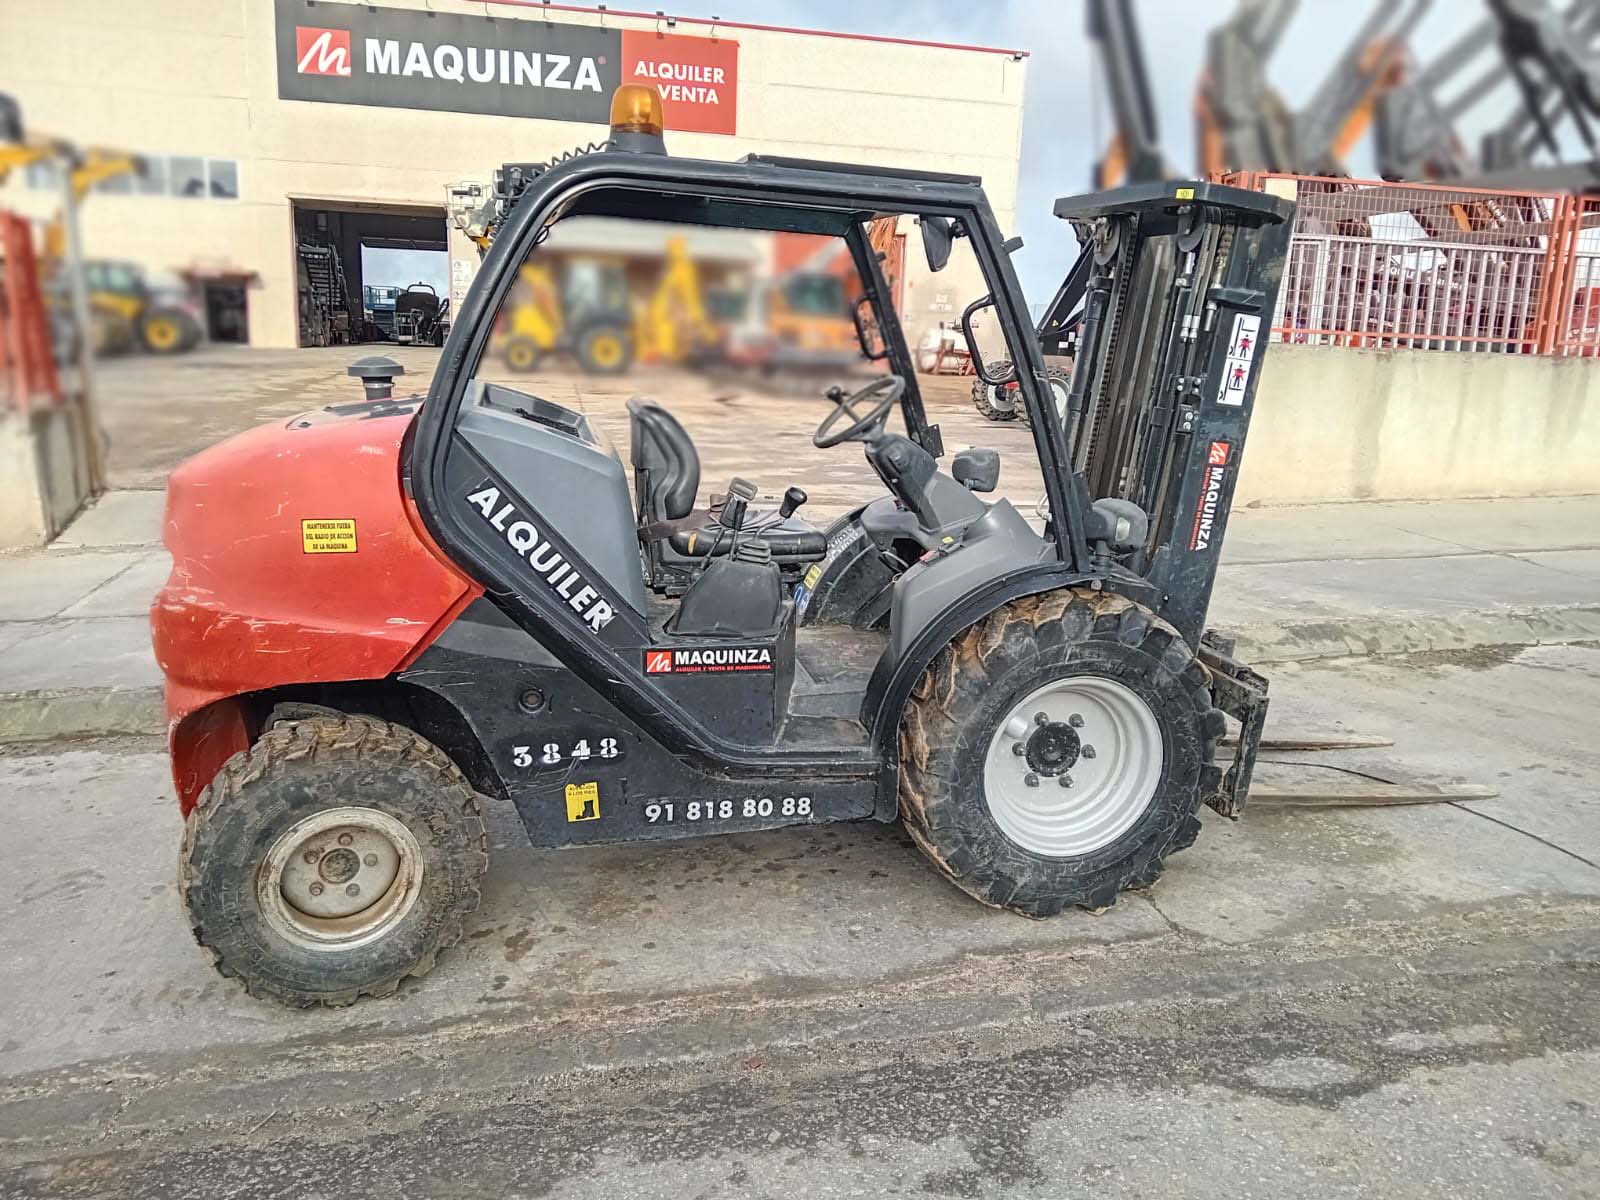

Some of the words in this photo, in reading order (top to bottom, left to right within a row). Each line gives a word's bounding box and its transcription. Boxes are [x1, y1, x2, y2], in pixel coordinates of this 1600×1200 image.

[365, 38, 603, 92] MAQUINZA
[634, 60, 725, 83] ALQUILER
[657, 83, 719, 104] VENTA
[1195, 467, 1224, 551] MAQUINZA
[466, 486, 617, 635] ALQUILER
[675, 649, 771, 665] MAQUINZA
[645, 804, 674, 823] 91
[686, 800, 733, 819] 818
[743, 799, 774, 817] 80
[781, 797, 811, 816] 88
